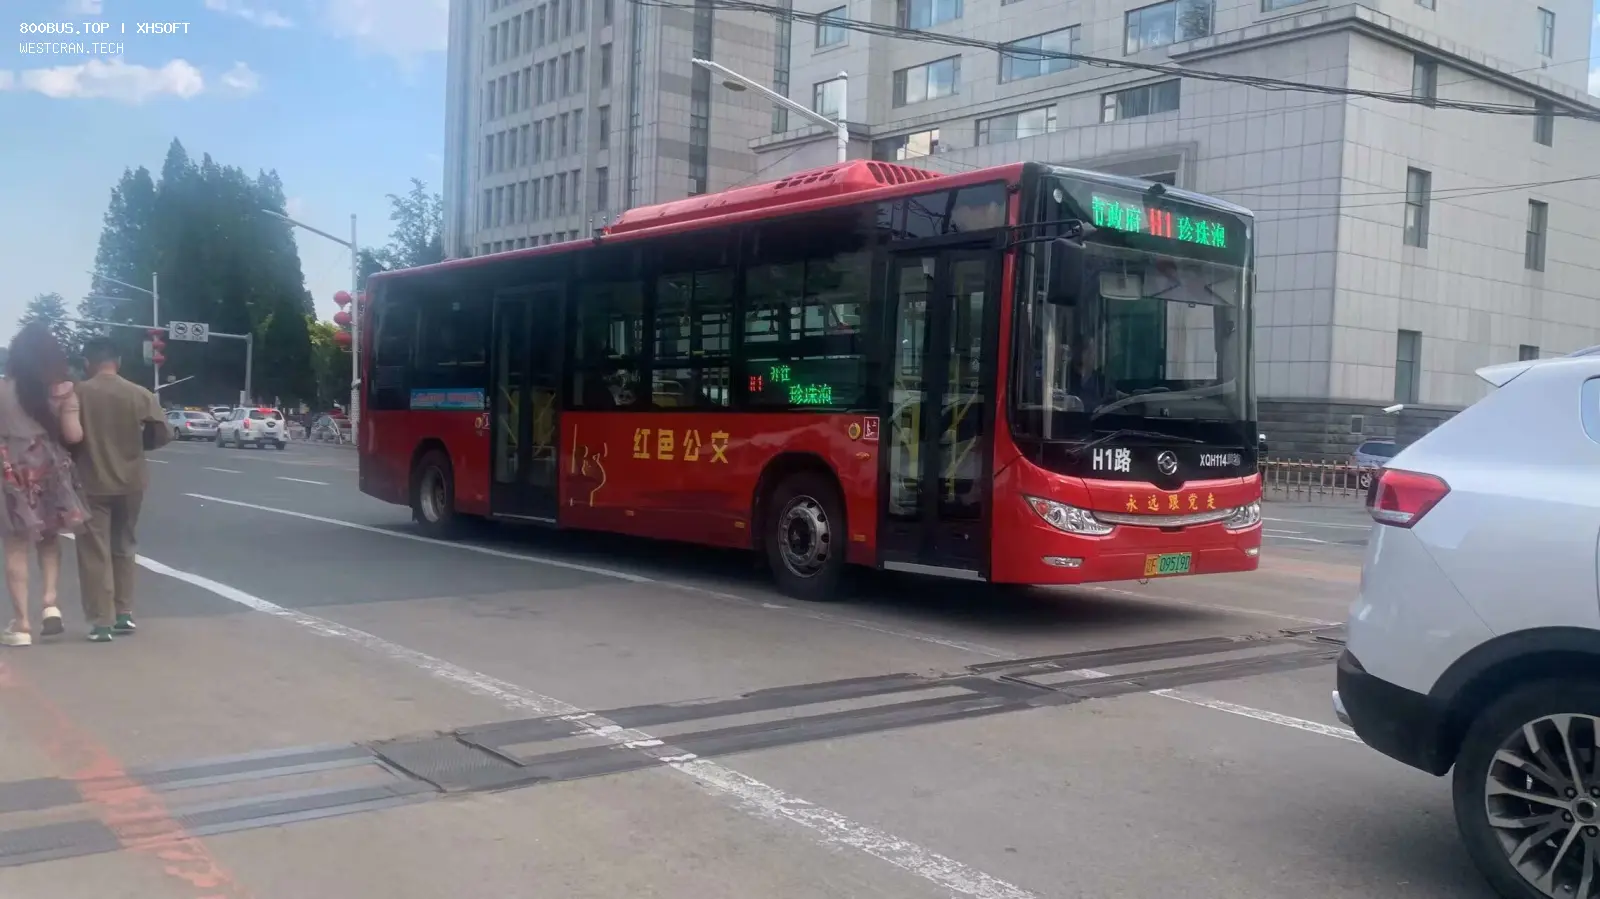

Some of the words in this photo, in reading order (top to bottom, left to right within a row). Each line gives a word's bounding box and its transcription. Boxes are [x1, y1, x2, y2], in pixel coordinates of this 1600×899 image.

[1148, 207, 1171, 238] H1
[749, 375, 763, 392] H1
[633, 427, 730, 464] 红色公交
[1092, 447, 1132, 473] H1路
[1126, 492, 1217, 512] 永远跟党走
